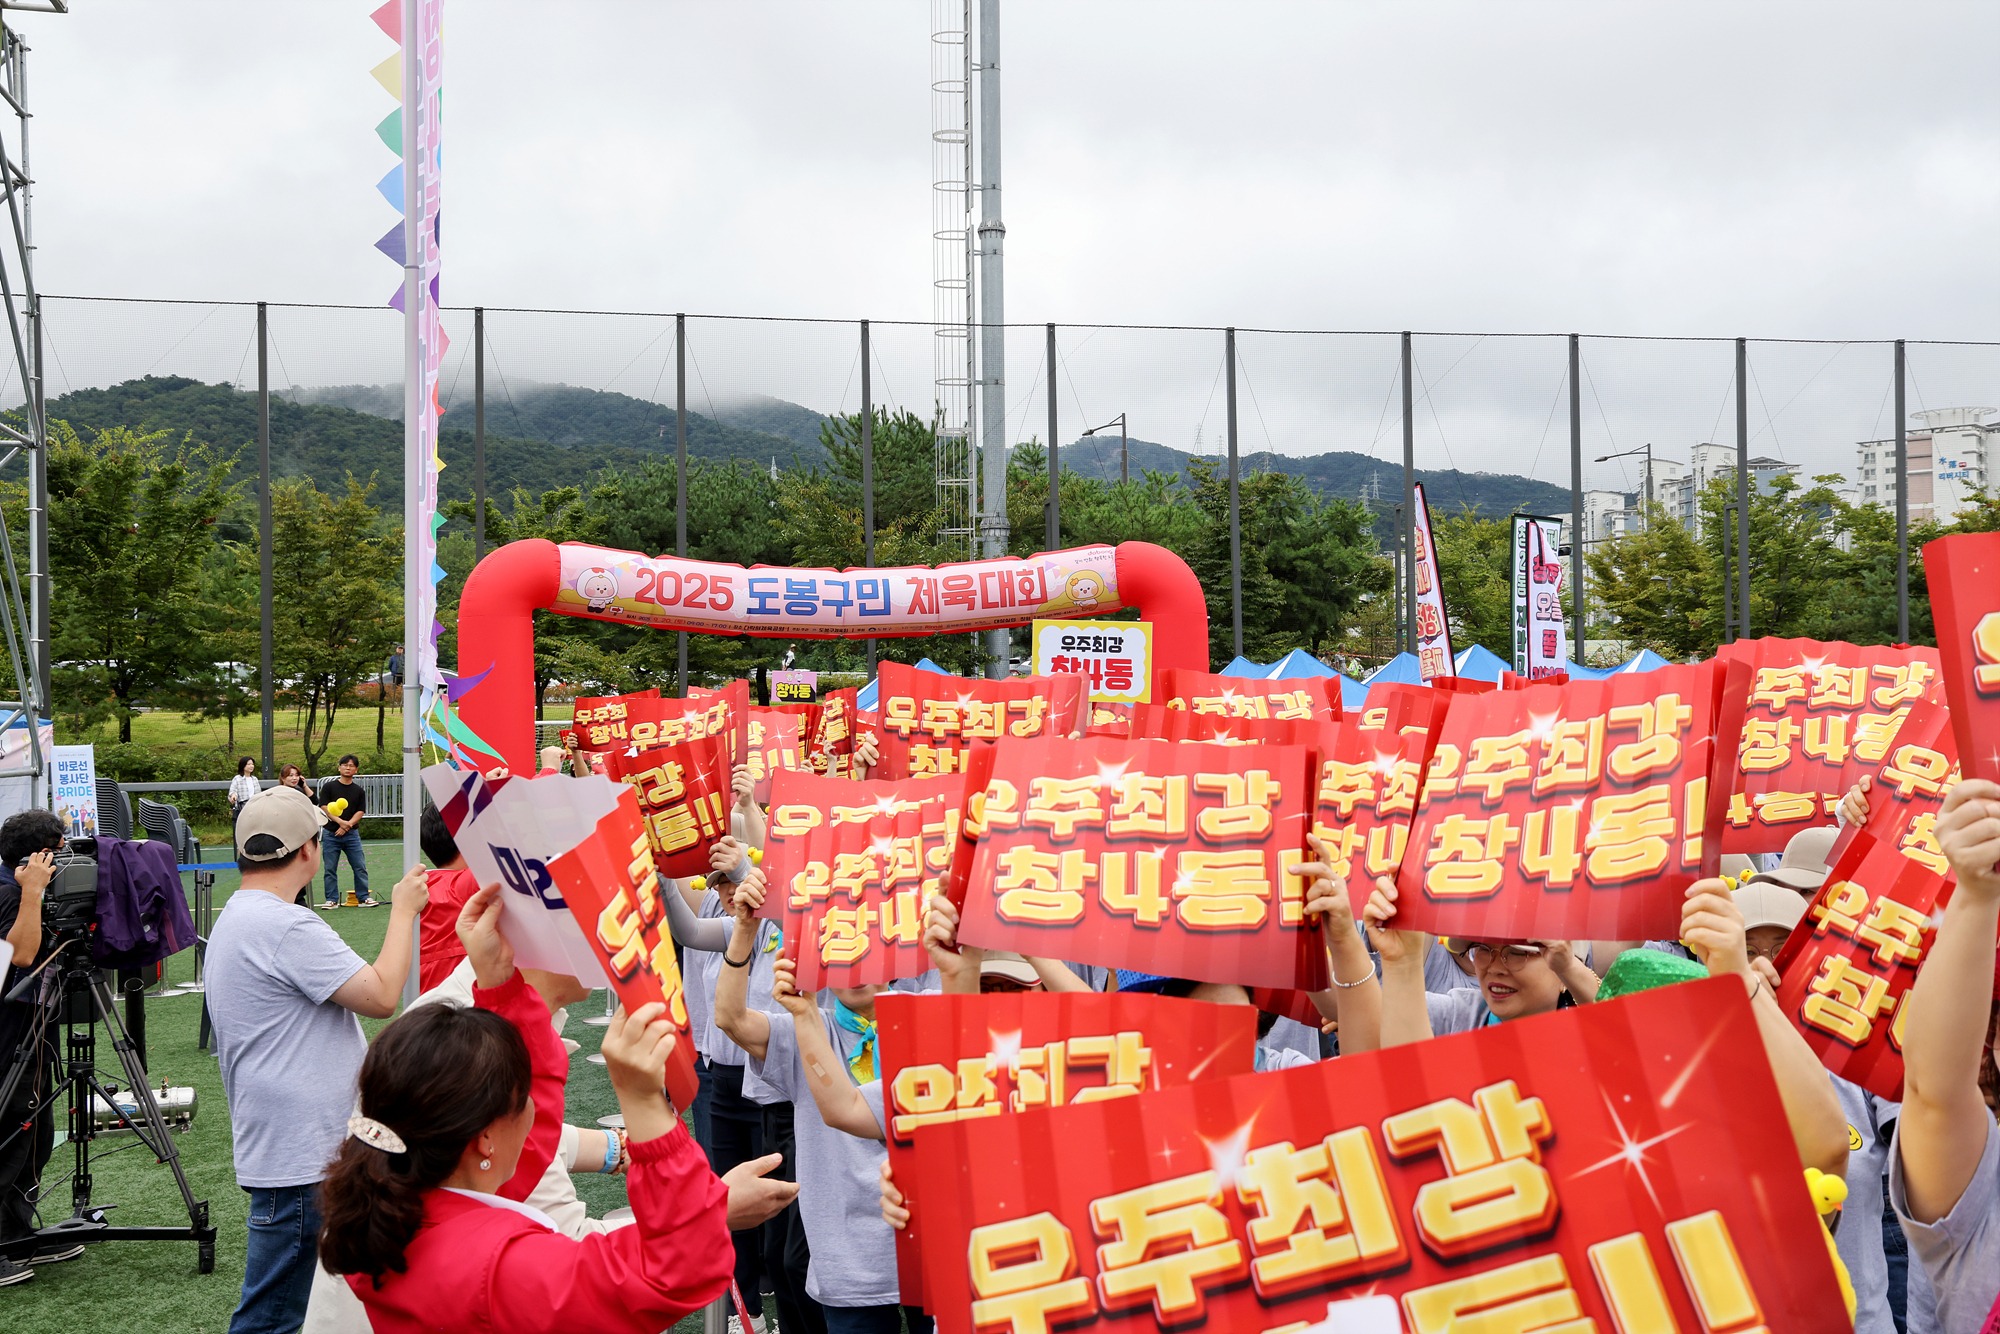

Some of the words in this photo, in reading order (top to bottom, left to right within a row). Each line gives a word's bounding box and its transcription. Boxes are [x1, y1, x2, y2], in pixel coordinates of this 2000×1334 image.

[1938, 471, 1969, 480] 리버시티
[634, 568, 734, 611] 2025
[747, 577, 891, 618] 도봉구민
[906, 566, 1049, 615] 체육대회
[1061, 635, 1124, 653] 우주최강
[776, 681, 812, 699] 창4동
[574, 701, 629, 727] 우주최
[883, 695, 1048, 743] 우주최강
[589, 722, 628, 747] 창4
[1419, 692, 1694, 812] 우주최강
[58, 760, 88, 772] 바로선
[59, 773, 89, 785] 봉사단
[57, 785, 93, 798] BRIDE
[962, 769, 1283, 845] 우주최강
[787, 808, 960, 911] 우주최강
[818, 878, 941, 971] 창4
[1806, 879, 1935, 972] 우주
[966, 1078, 1556, 1334] 우주최강
